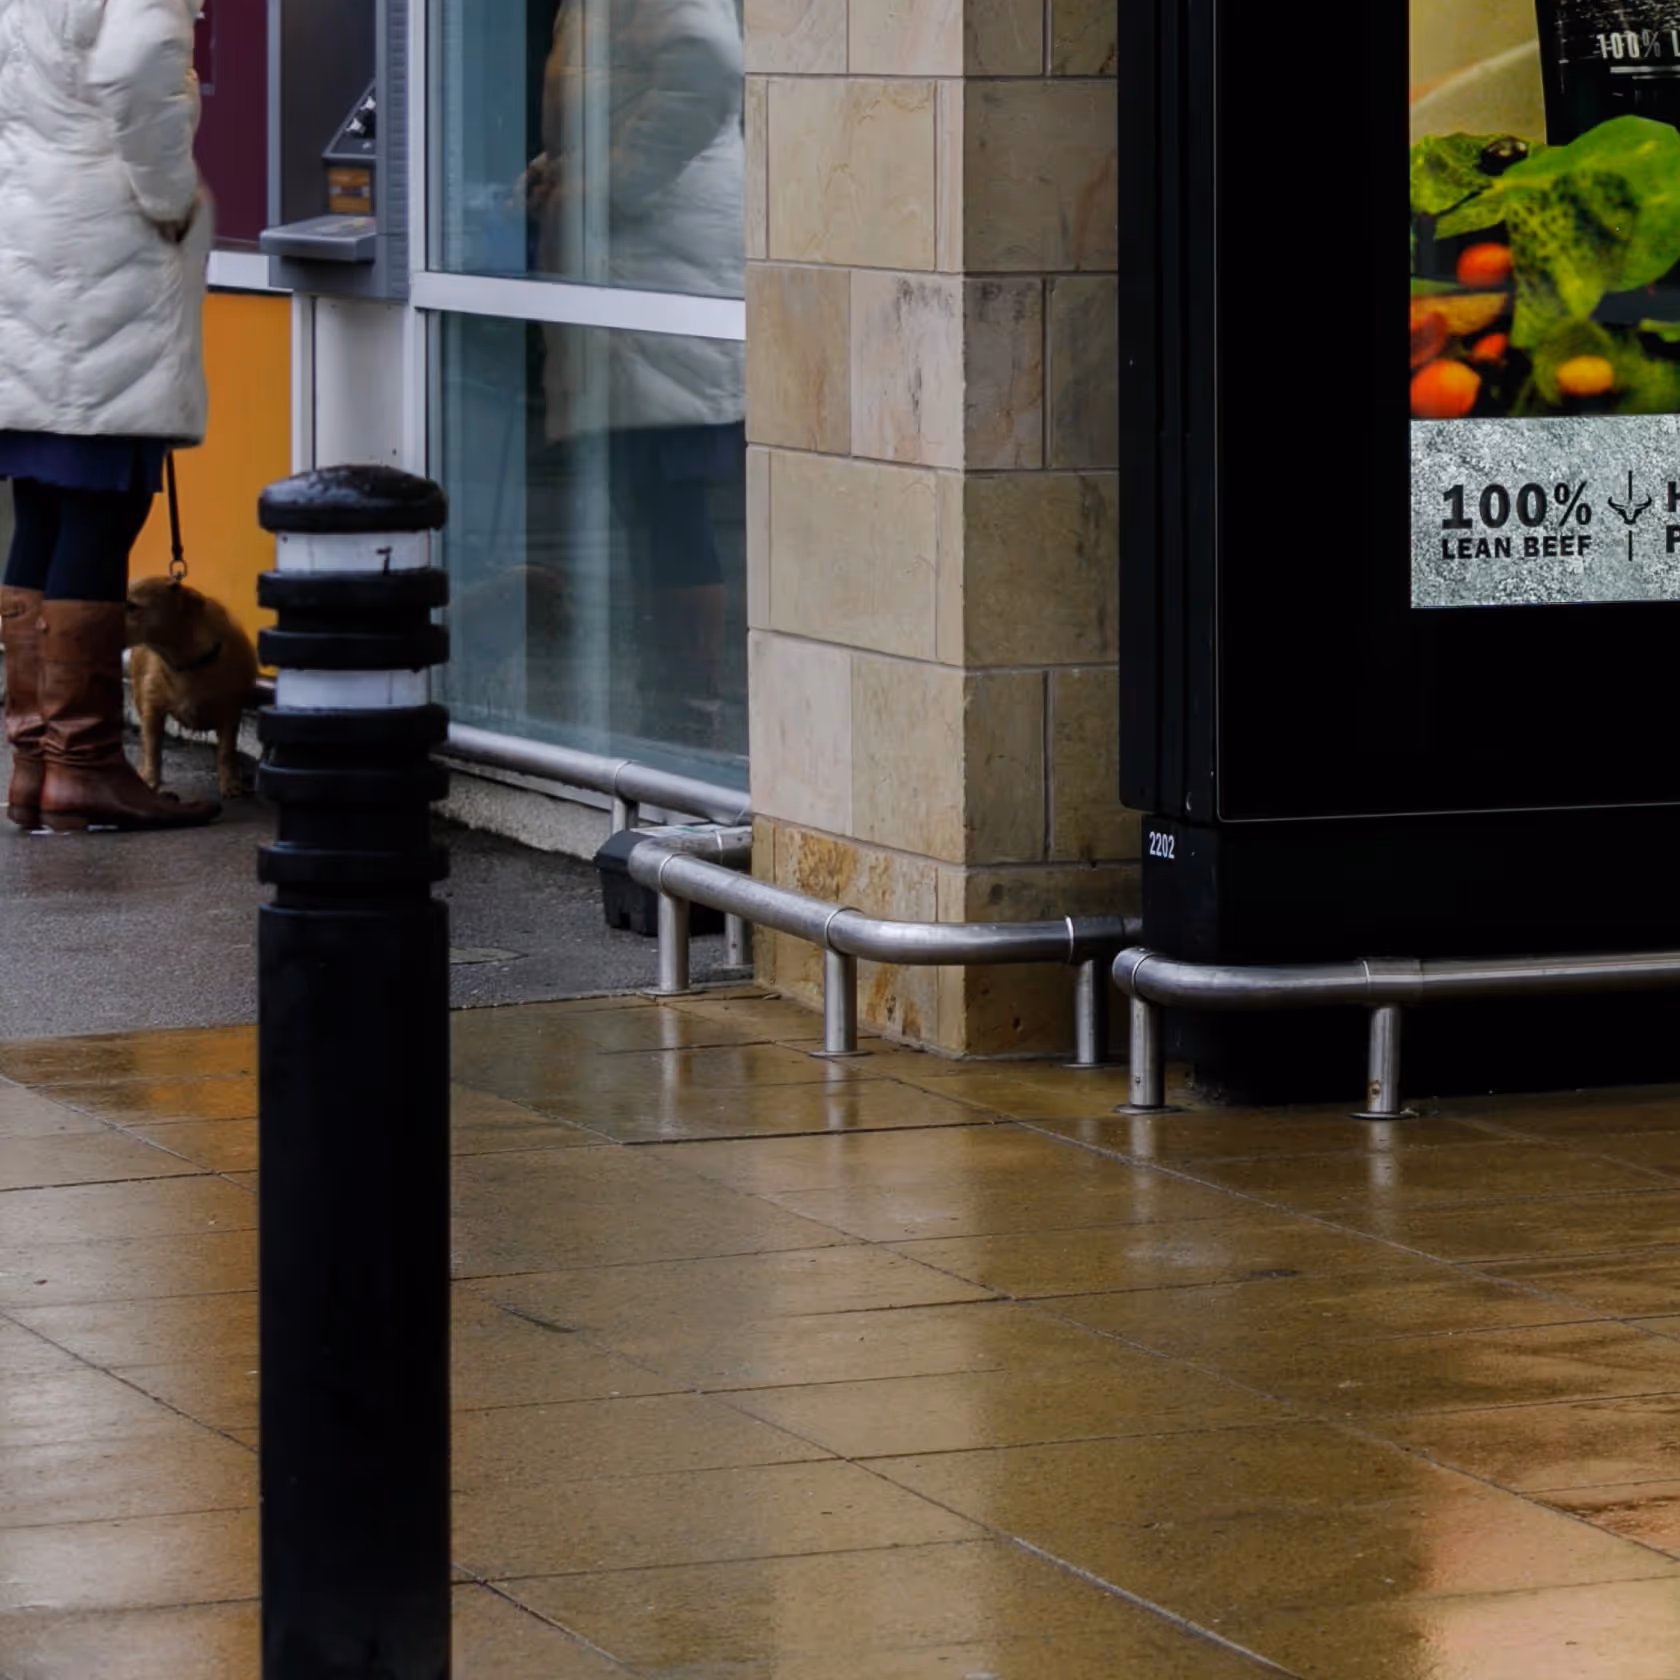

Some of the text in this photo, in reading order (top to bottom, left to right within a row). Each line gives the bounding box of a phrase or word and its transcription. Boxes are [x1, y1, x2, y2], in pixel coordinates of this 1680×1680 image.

[1599, 30, 1662, 59] 100%
[1442, 481, 1593, 531] 100%
[1441, 534, 1592, 560] LEAN BEEF
[1149, 831, 1175, 859] 2202
